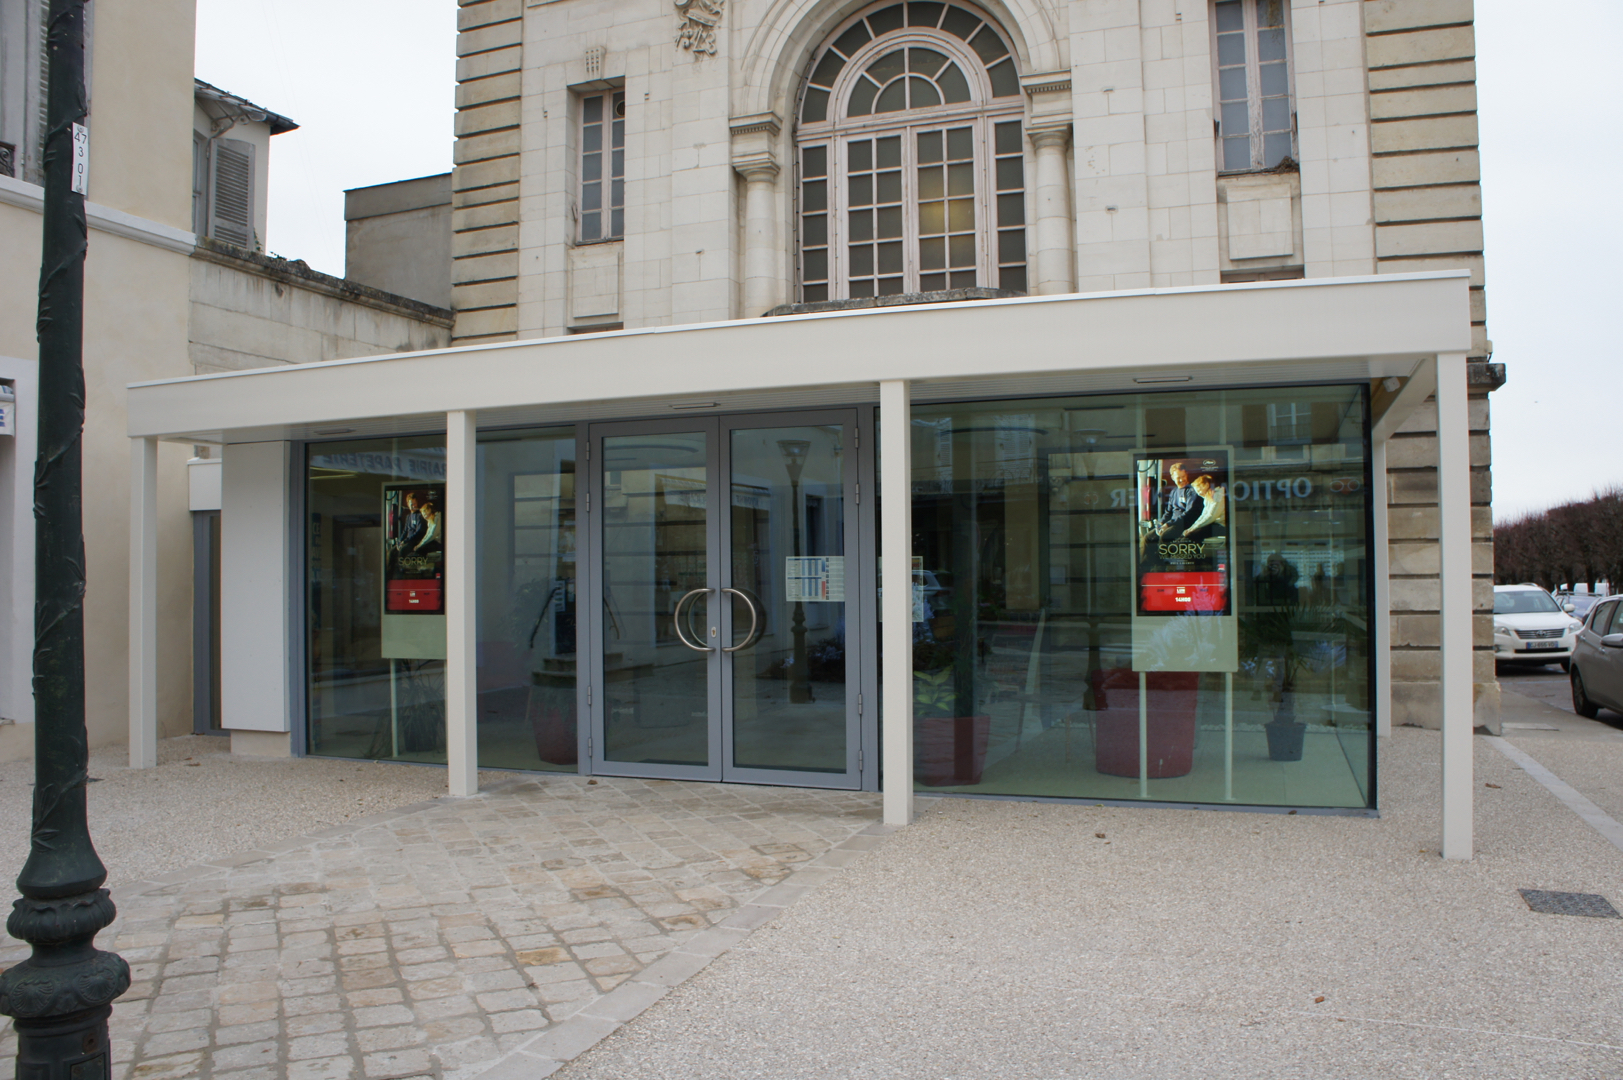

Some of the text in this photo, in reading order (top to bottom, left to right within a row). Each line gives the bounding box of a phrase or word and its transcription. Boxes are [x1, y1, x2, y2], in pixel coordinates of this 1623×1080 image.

[74, 132, 87, 144] 47
[1158, 543, 1206, 555] SORRY
[398, 556, 429, 566] SORRY
